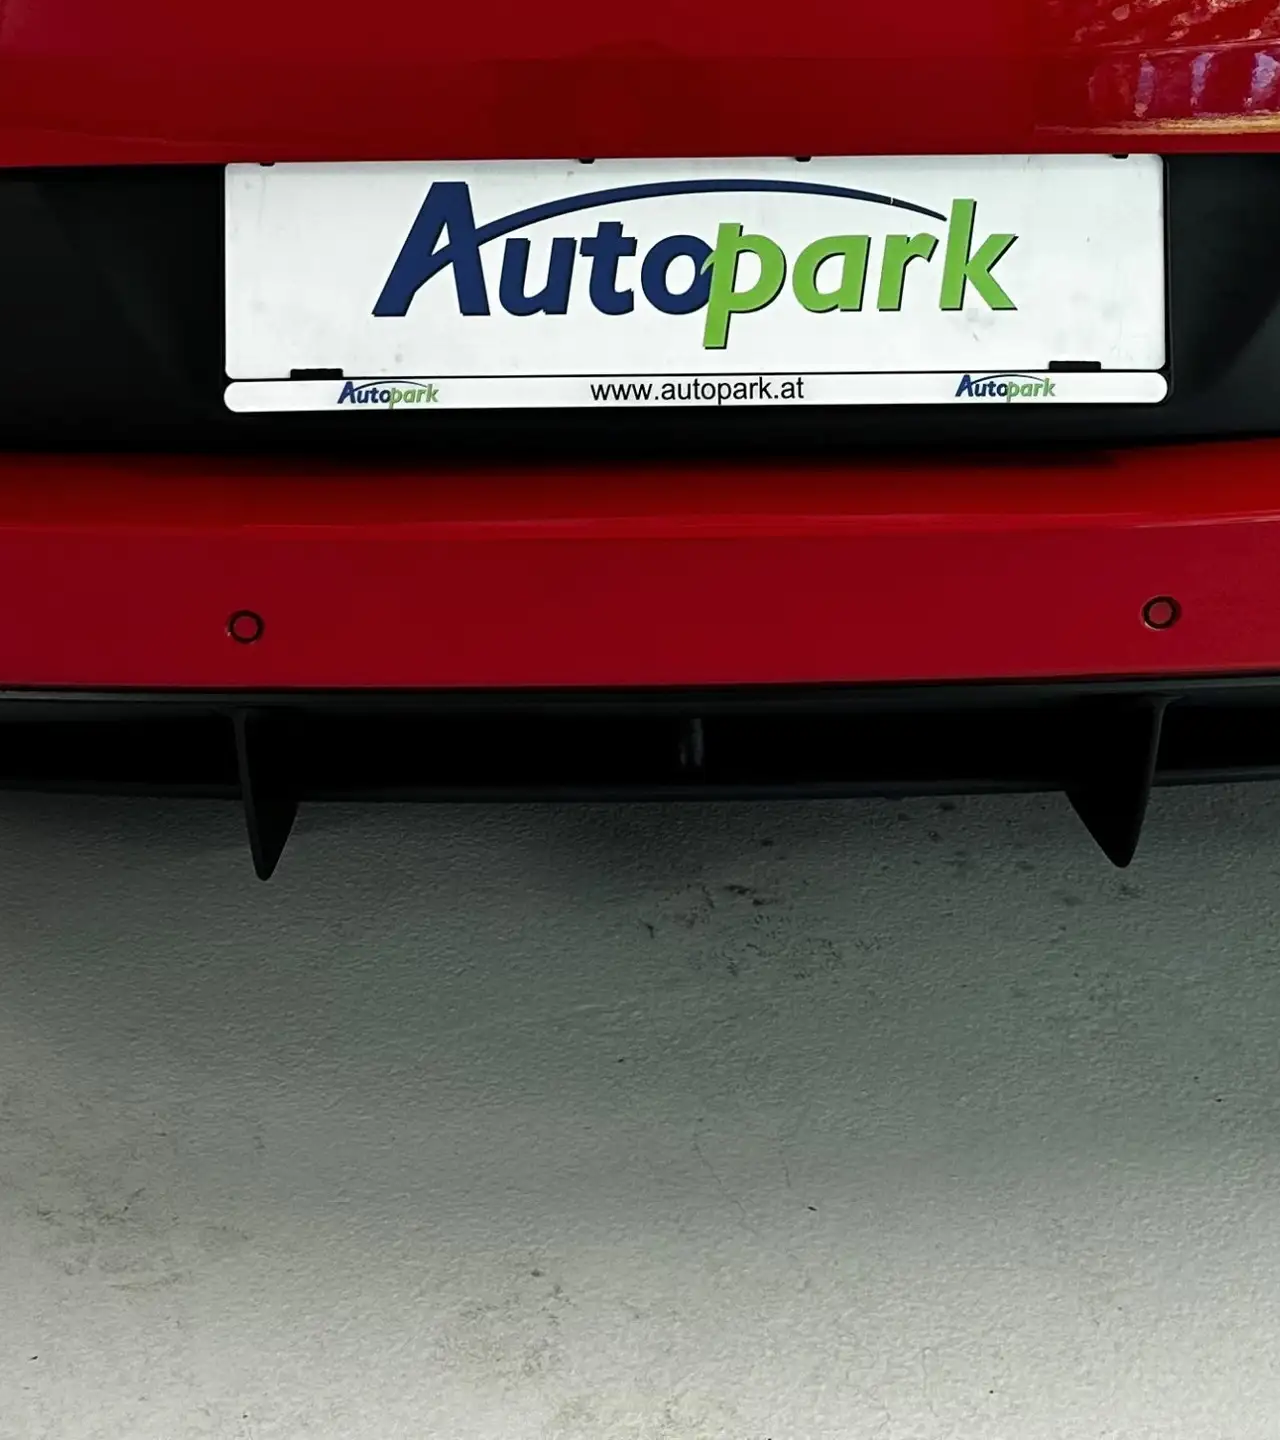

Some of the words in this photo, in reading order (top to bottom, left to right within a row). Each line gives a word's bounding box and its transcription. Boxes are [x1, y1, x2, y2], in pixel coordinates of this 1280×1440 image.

[371, 179, 1018, 349] Autopark
[337, 381, 439, 409] Autopark
[590, 376, 805, 405] www.autopark.at
[955, 373, 1056, 403] Autopark
